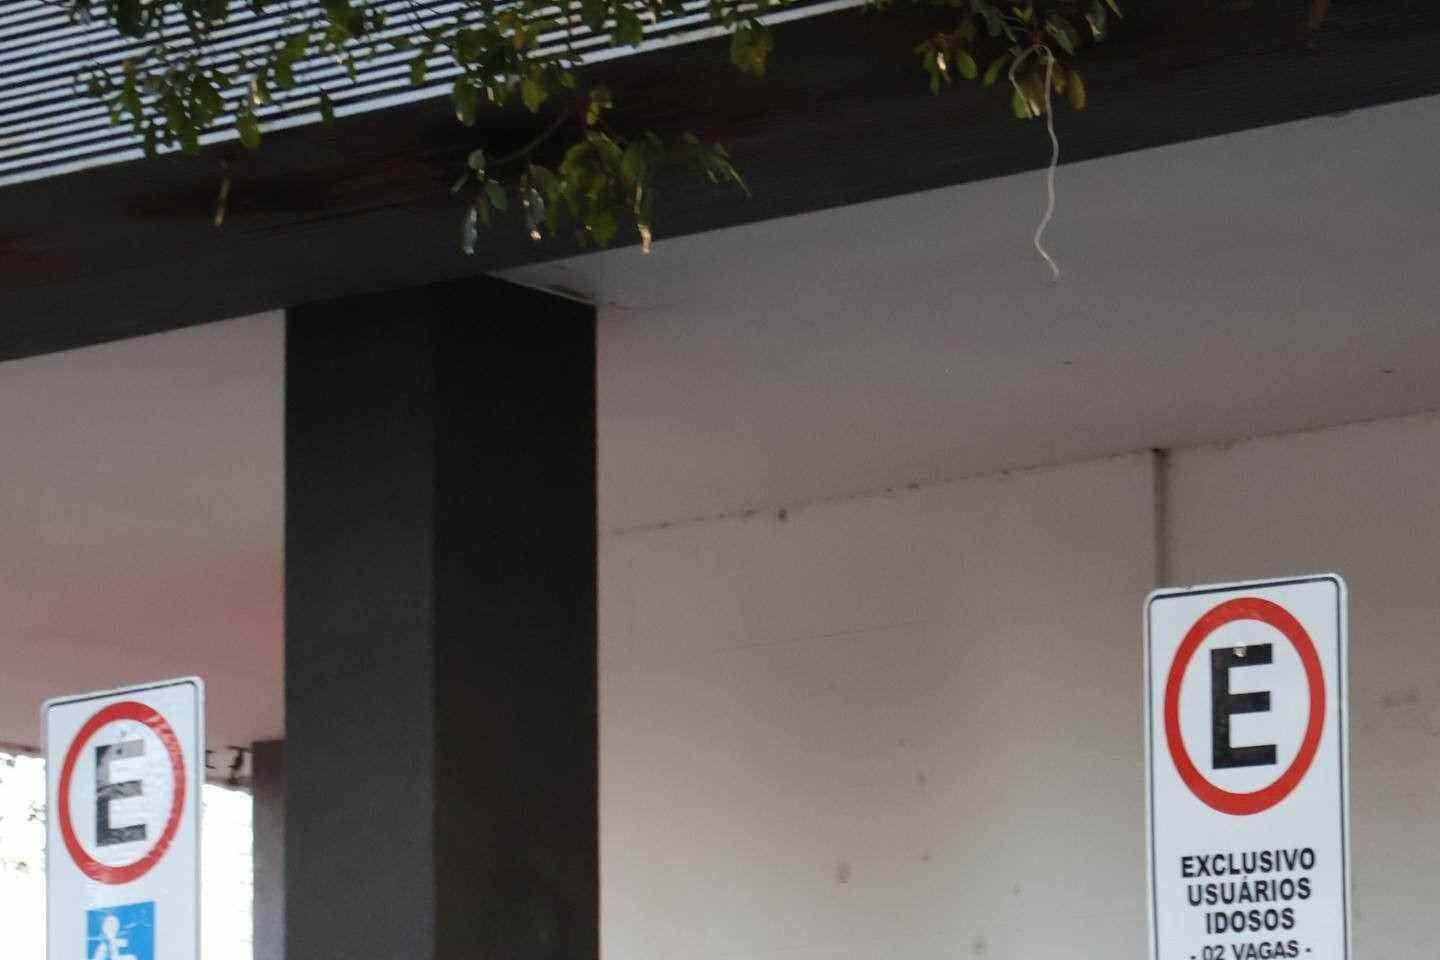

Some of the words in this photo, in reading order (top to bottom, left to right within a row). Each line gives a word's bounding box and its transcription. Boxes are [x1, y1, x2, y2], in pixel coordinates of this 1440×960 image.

[1211, 643, 1277, 769] E
[95, 739, 146, 847] E
[1181, 848, 1315, 878] EXCLUSIVO
[1188, 876, 1312, 906] USUÁRIOS
[1206, 907, 1295, 934] IDOSOS
